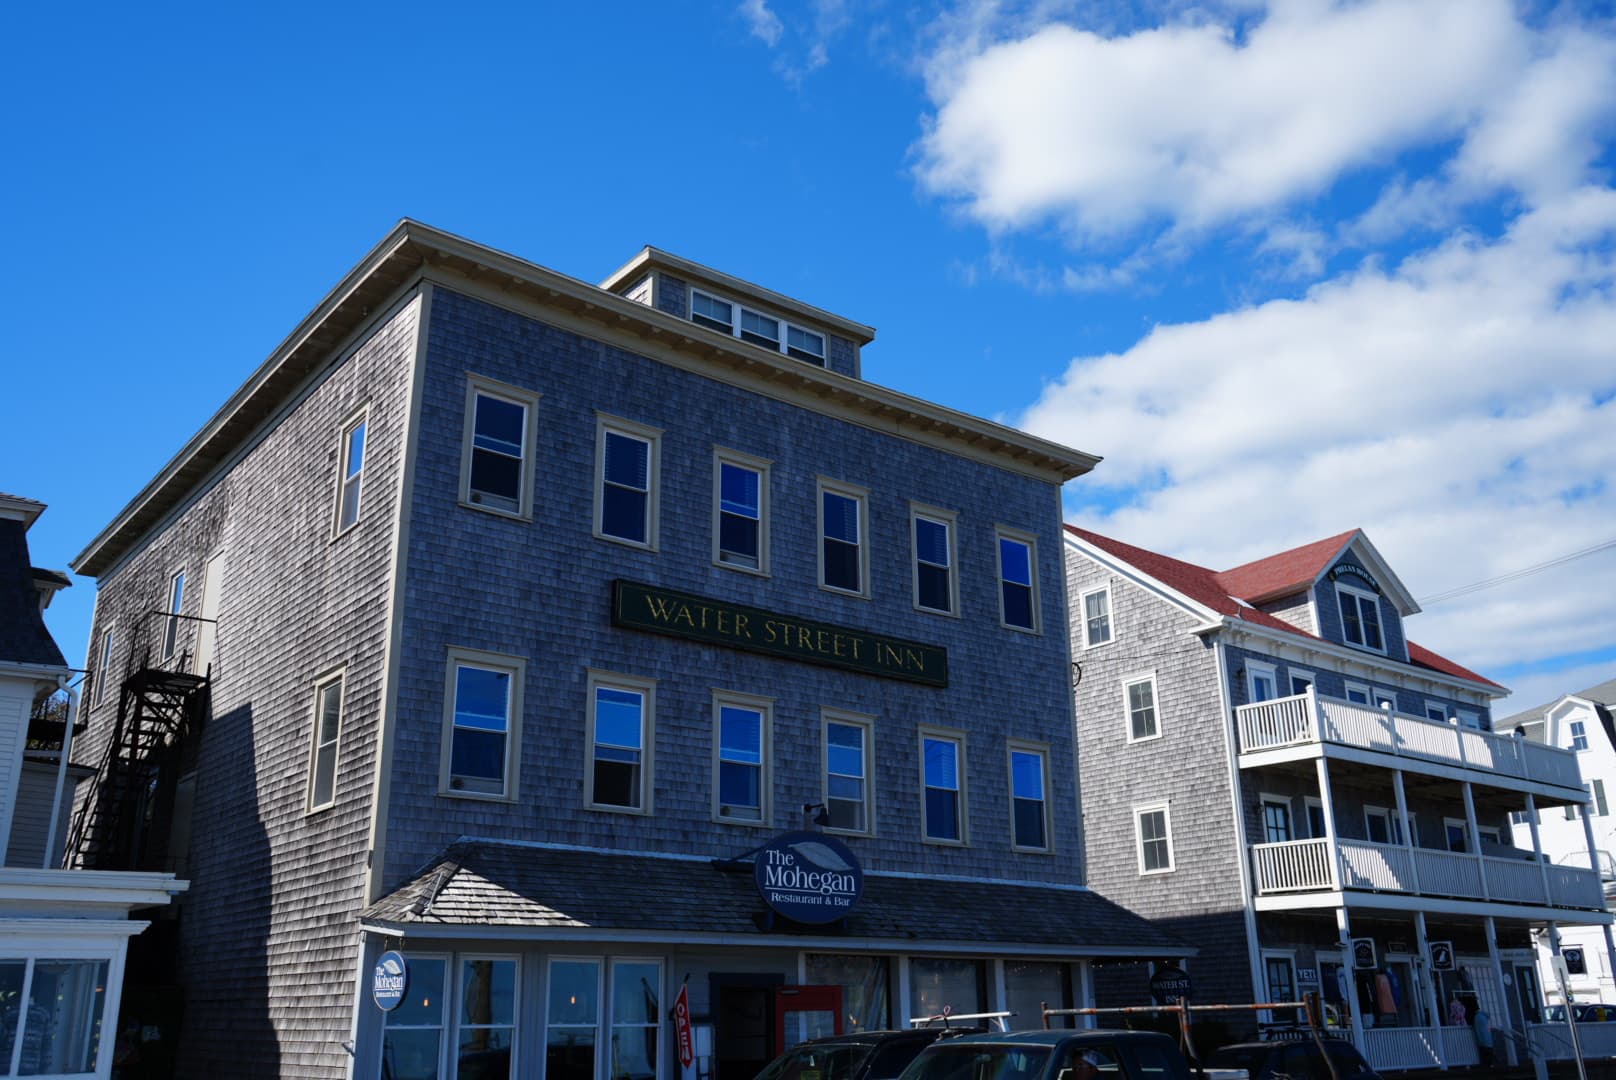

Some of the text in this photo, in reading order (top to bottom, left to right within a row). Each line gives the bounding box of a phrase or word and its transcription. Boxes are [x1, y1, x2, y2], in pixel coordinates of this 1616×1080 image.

[645, 594, 925, 672] WATER STREET INN
[765, 849, 794, 866] The
[765, 865, 856, 896] Mohegan
[771, 892, 850, 906] Restaurant & Bar
[1297, 969, 1316, 978] YETI
[676, 1002, 691, 1061] OPEN
